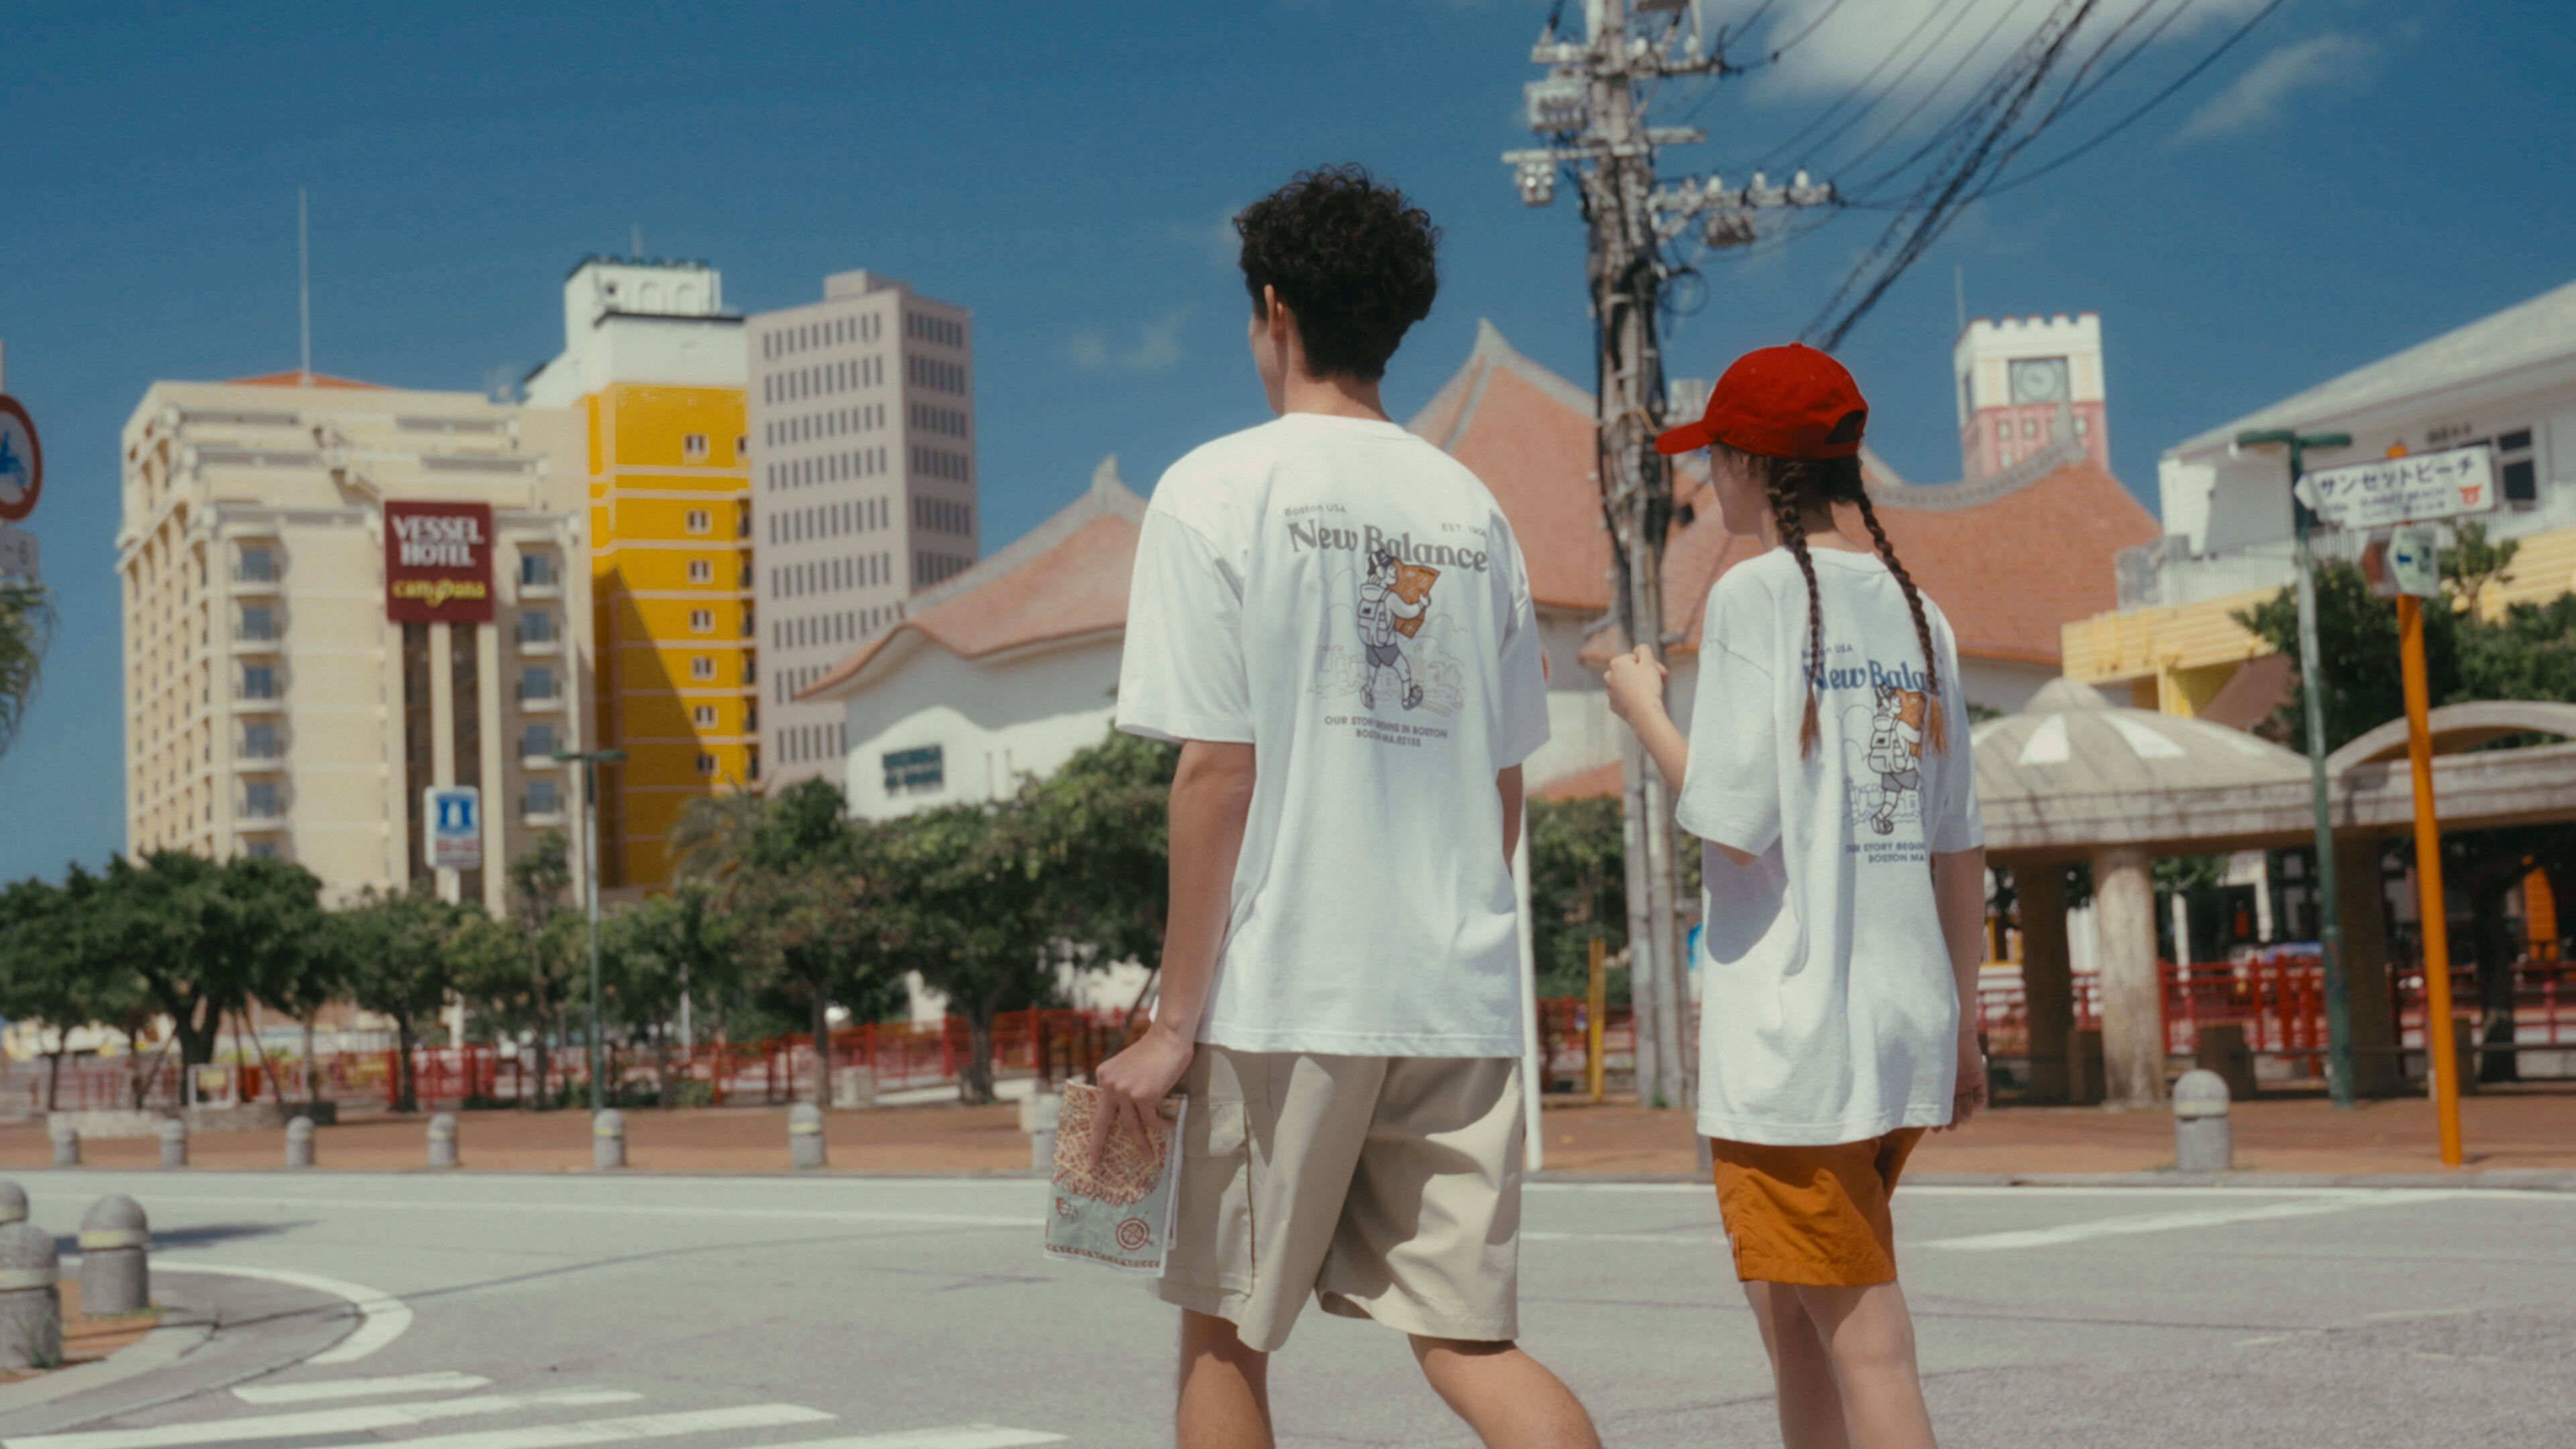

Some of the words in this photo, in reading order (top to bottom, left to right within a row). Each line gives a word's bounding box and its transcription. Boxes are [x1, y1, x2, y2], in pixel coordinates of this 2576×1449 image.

[1284, 504, 1323, 517] Boston
[1326, 502, 1346, 514] USA
[391, 514, 484, 544] VESSEL
[400, 539, 475, 567] HOTEL
[1288, 519, 1358, 553] New
[1363, 524, 1487, 570] Balance
[1835, 643, 1854, 653] USA
[1803, 661, 1866, 690] New
[1324, 715, 1347, 724] OUR
[1401, 724, 1410, 733] IN
[1411, 725, 1448, 739] BOSTON
[1863, 842, 1892, 851] STORY
[1868, 853, 1907, 863] BOSTON
